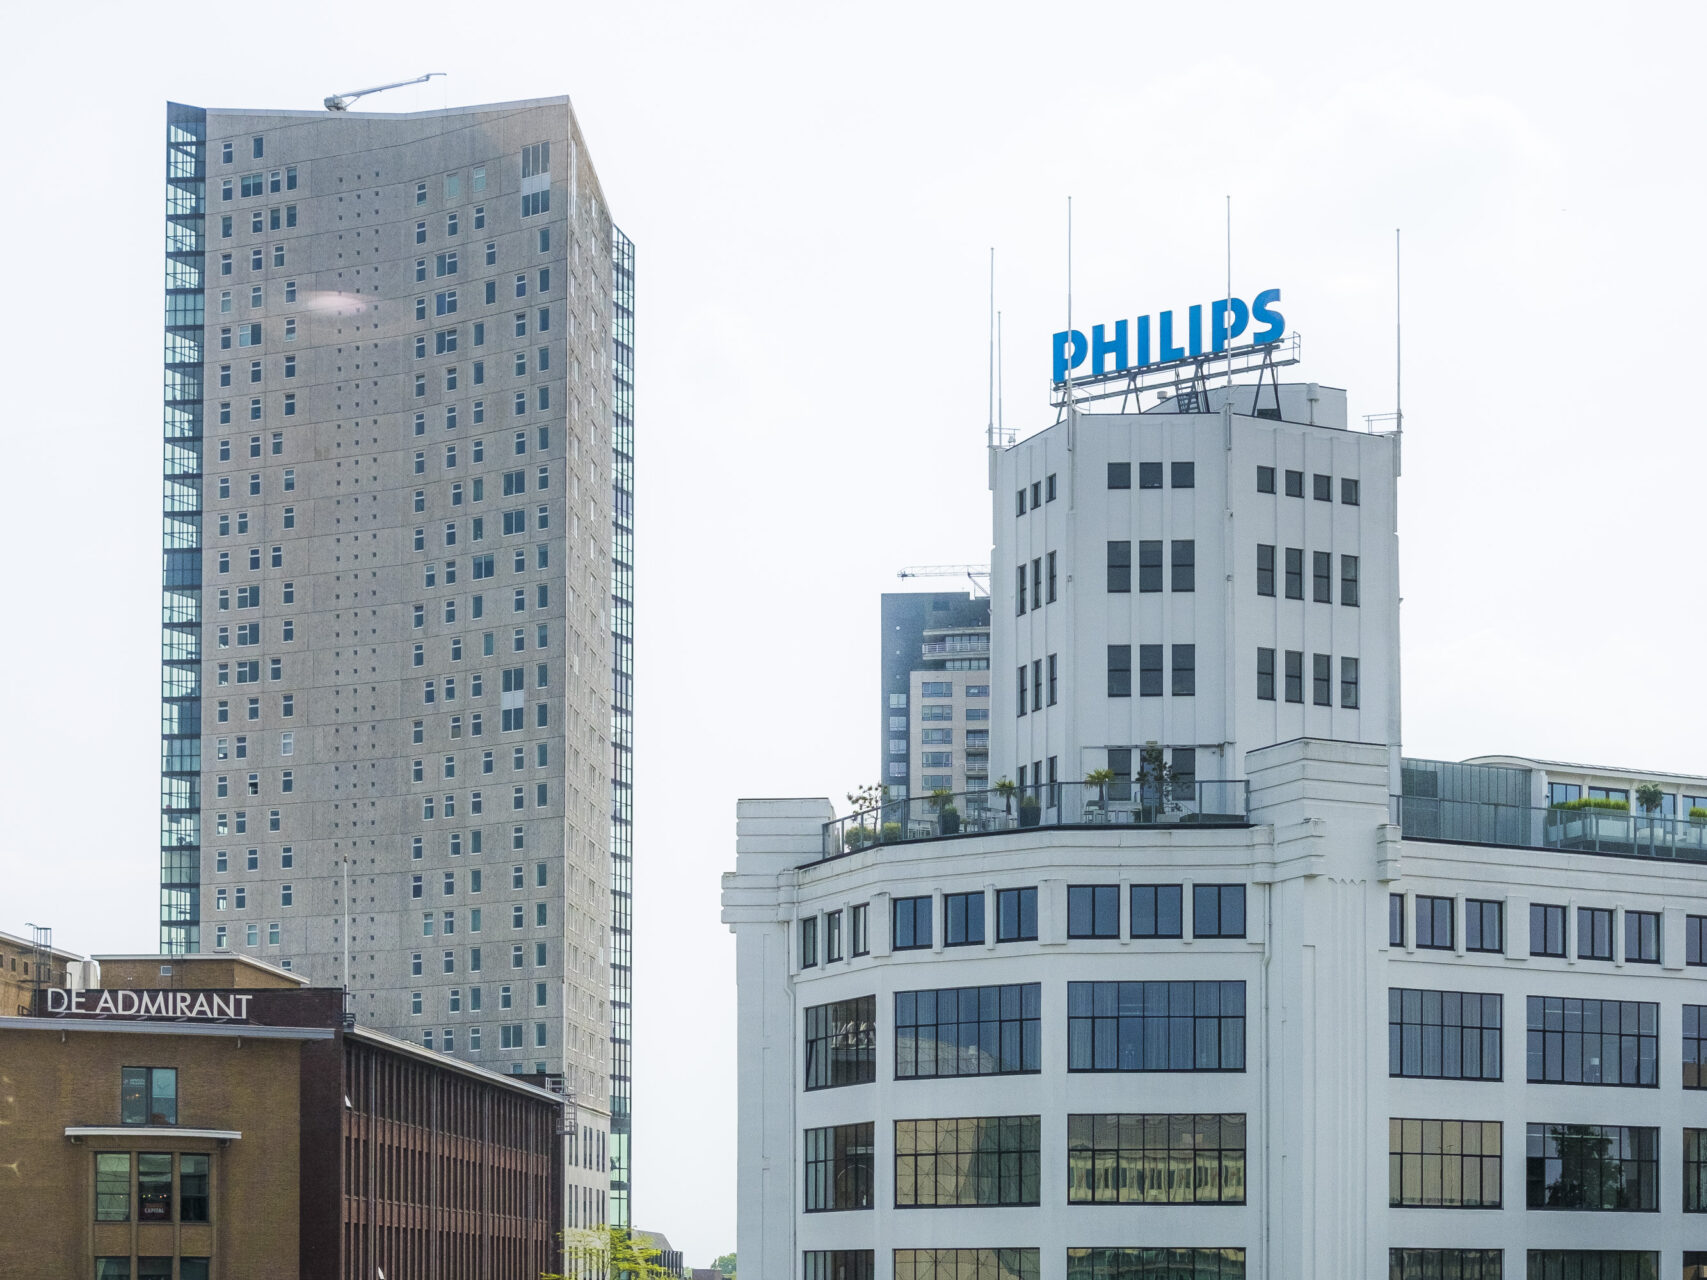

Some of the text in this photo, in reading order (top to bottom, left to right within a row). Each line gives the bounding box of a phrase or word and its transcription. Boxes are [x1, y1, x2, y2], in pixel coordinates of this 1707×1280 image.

[1053, 288, 1285, 384] PHILIPS
[47, 988, 253, 1019] DE ADMIRANT
